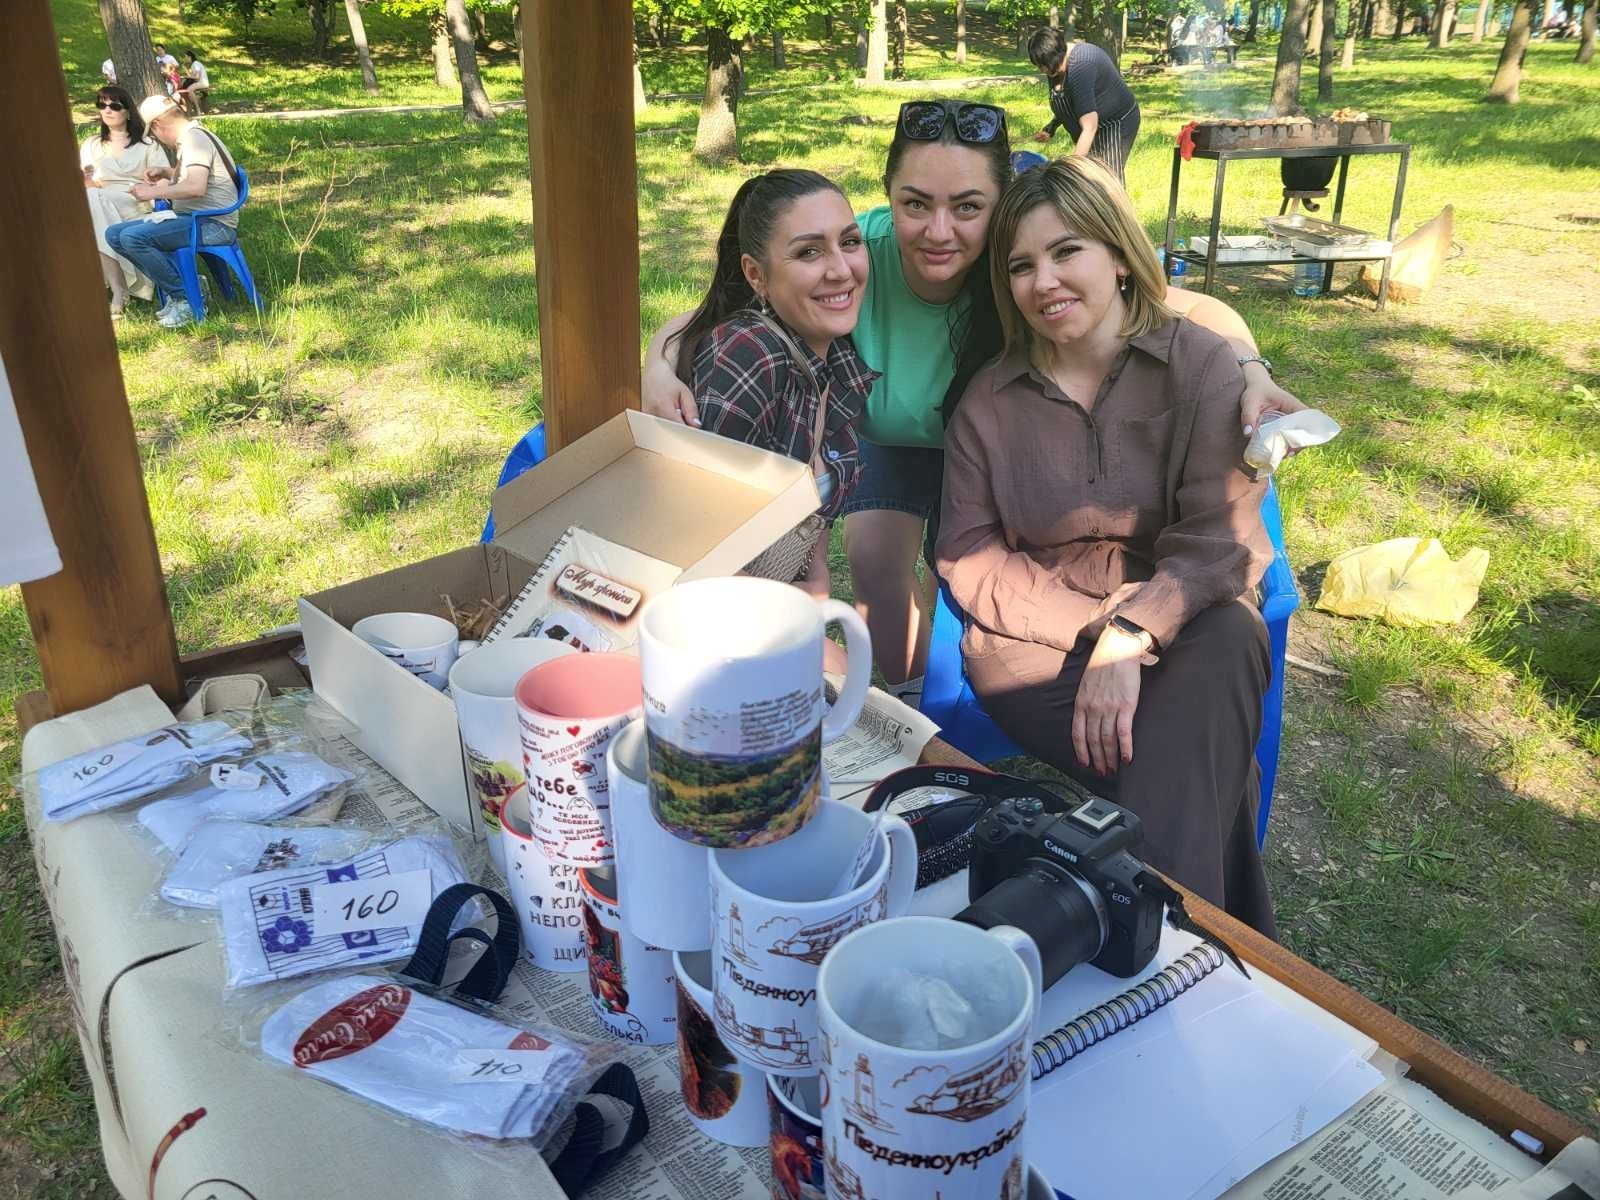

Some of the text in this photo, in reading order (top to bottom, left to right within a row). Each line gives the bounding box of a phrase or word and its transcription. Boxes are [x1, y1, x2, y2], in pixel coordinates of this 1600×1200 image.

[71, 752, 116, 783] 160
[933, 772, 970, 786] EOS
[535, 775, 578, 796] тебе
[1044, 839, 1079, 865] Canon
[341, 889, 400, 921] 160
[1112, 893, 1132, 905] EOS
